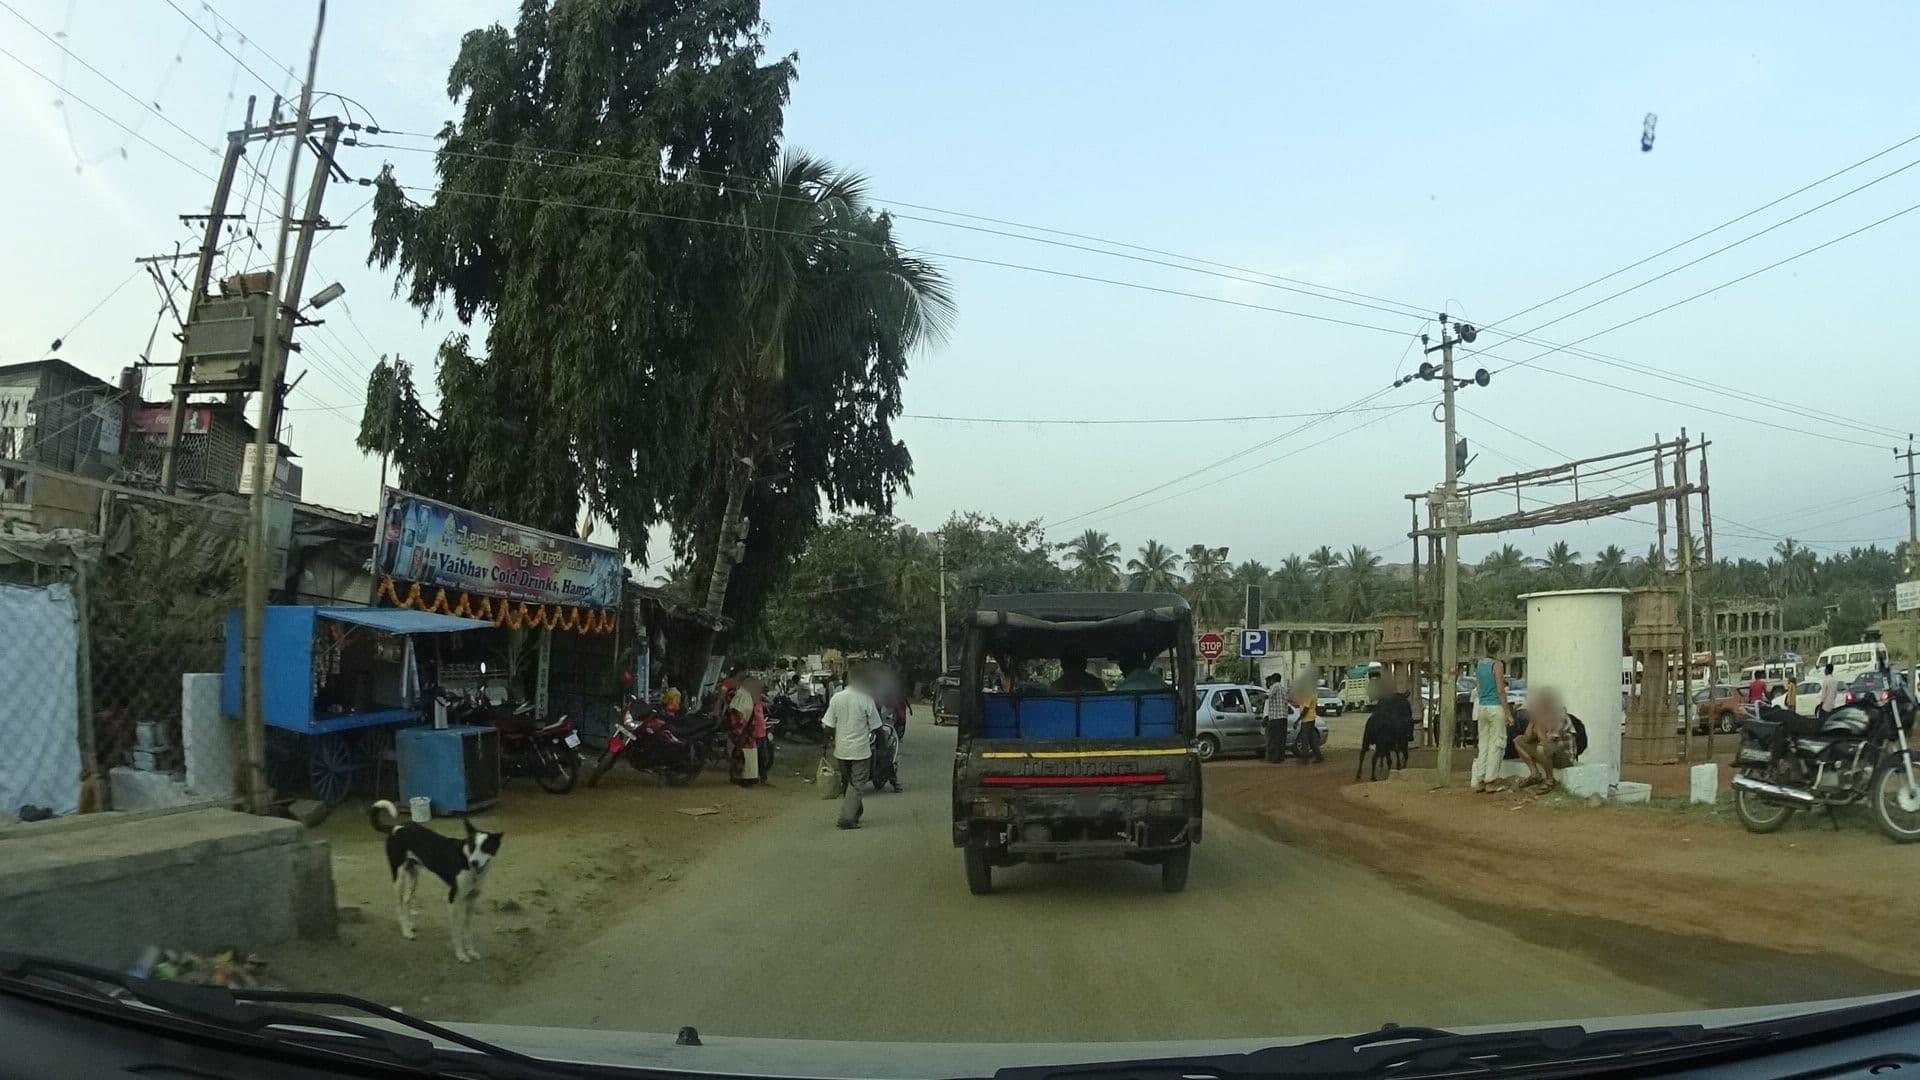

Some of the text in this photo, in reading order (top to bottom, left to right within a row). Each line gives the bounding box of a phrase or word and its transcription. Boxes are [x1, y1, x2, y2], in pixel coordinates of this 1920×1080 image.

[439, 553, 489, 578] Vaibhav
[491, 565, 517, 584] Cold
[519, 570, 559, 594] Drinks,
[561, 579, 595, 598] Hampi
[1200, 641, 1221, 651] STOP
[1245, 631, 1261, 650] P
